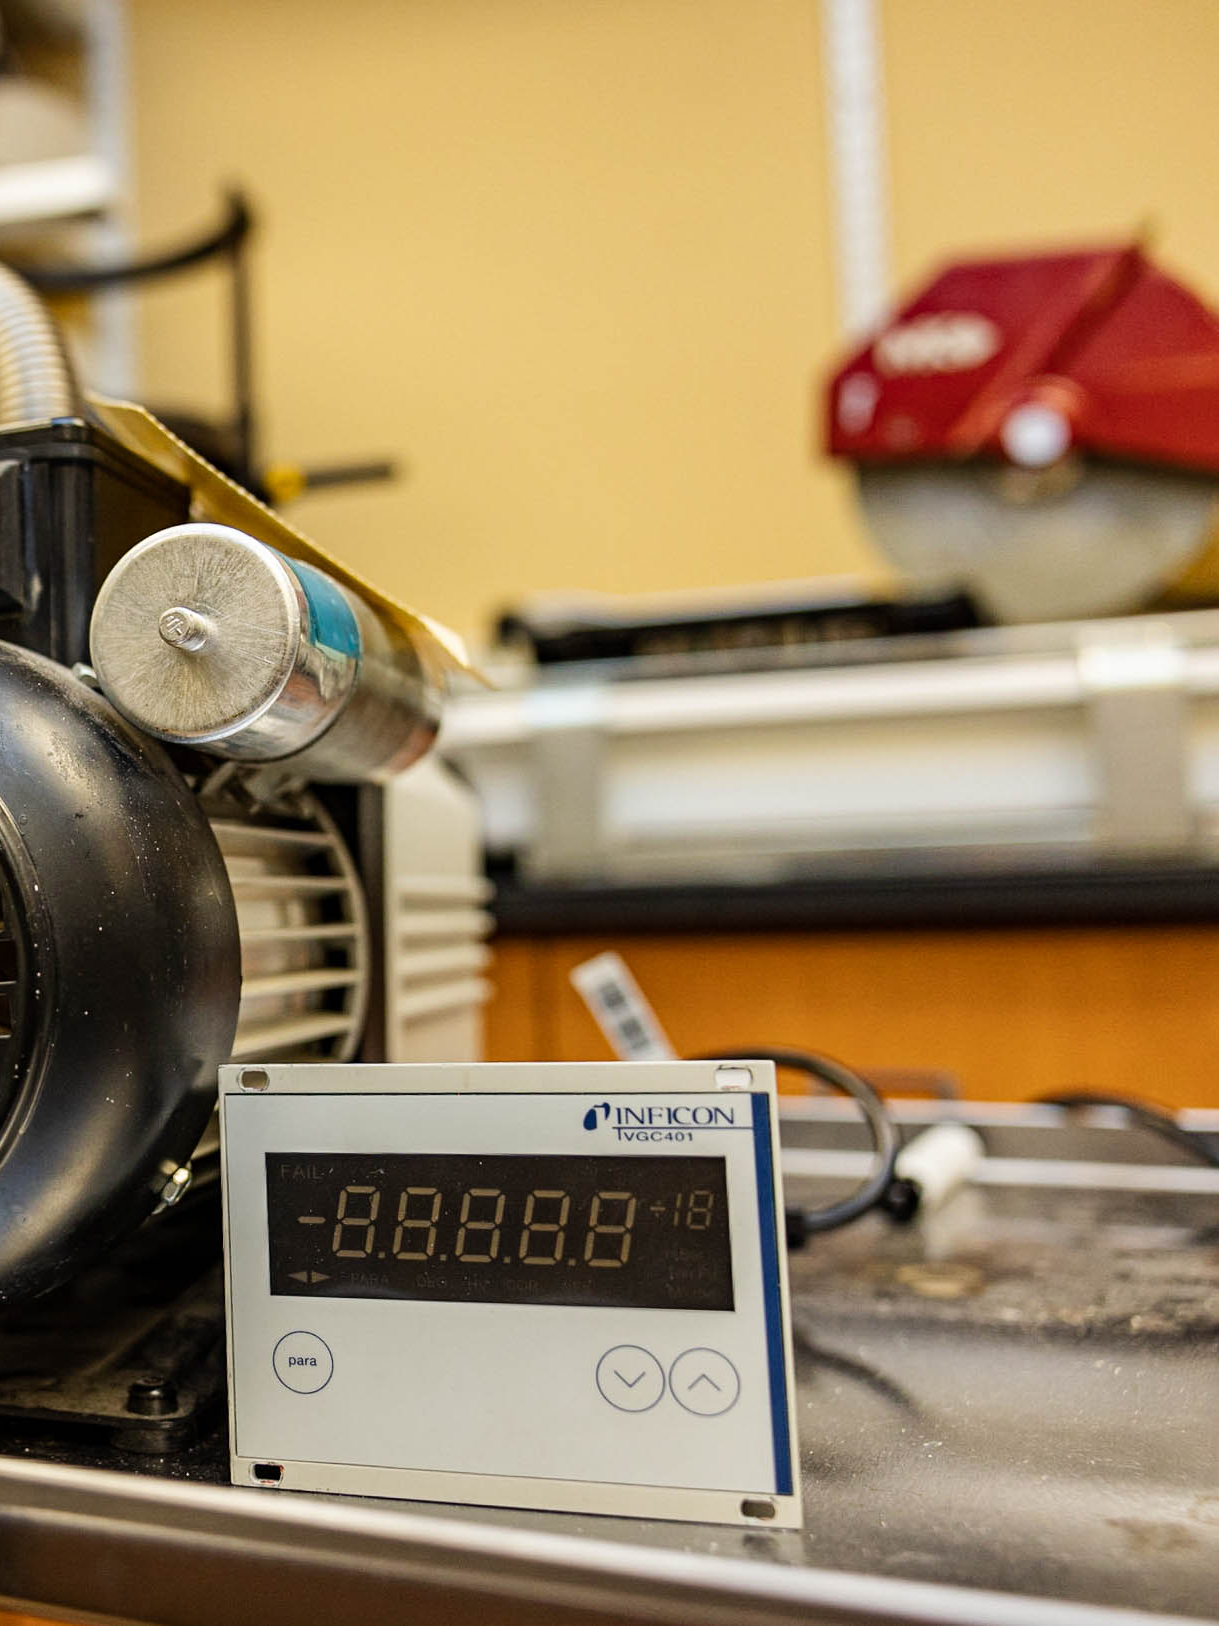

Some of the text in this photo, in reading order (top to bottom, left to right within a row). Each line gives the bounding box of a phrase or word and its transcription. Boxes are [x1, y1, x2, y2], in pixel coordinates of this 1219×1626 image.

[615, 1106, 734, 1126] INFICON
[280, 1164, 324, 1180] FAIL
[287, 1355, 318, 1368] para
